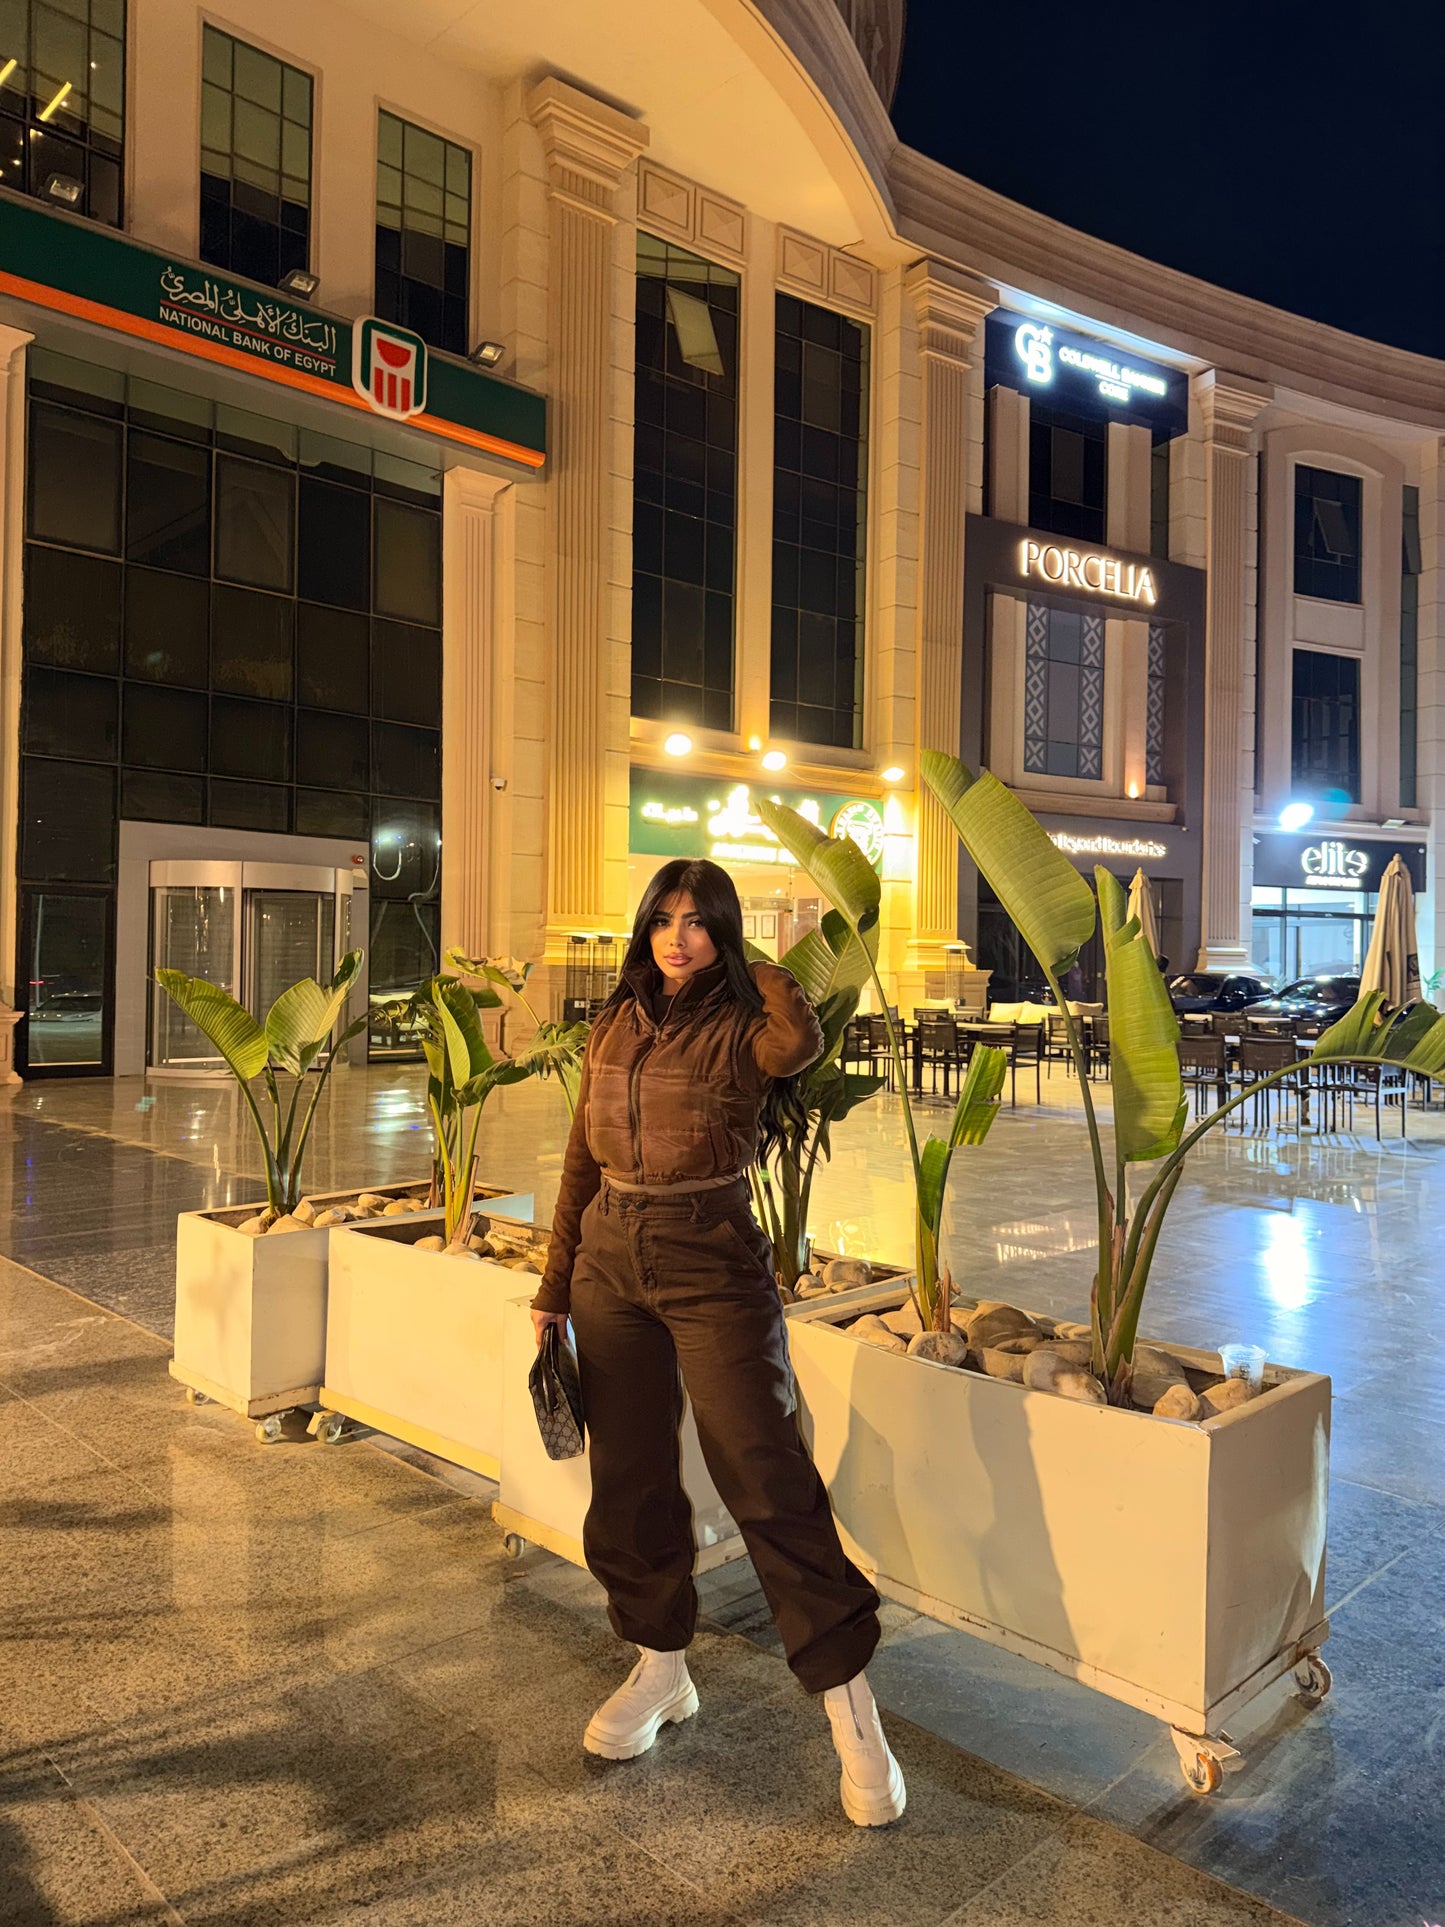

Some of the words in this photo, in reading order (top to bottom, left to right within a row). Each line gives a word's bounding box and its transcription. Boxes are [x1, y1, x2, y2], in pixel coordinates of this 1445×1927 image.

[159, 306, 229, 341] NATIONAL
[232, 331, 271, 356] BANK
[274, 346, 291, 361] OF
[295, 353, 336, 377] EGYPT
[1021, 538, 1157, 605] PORCELIA
[1301, 841, 1368, 877] elite
